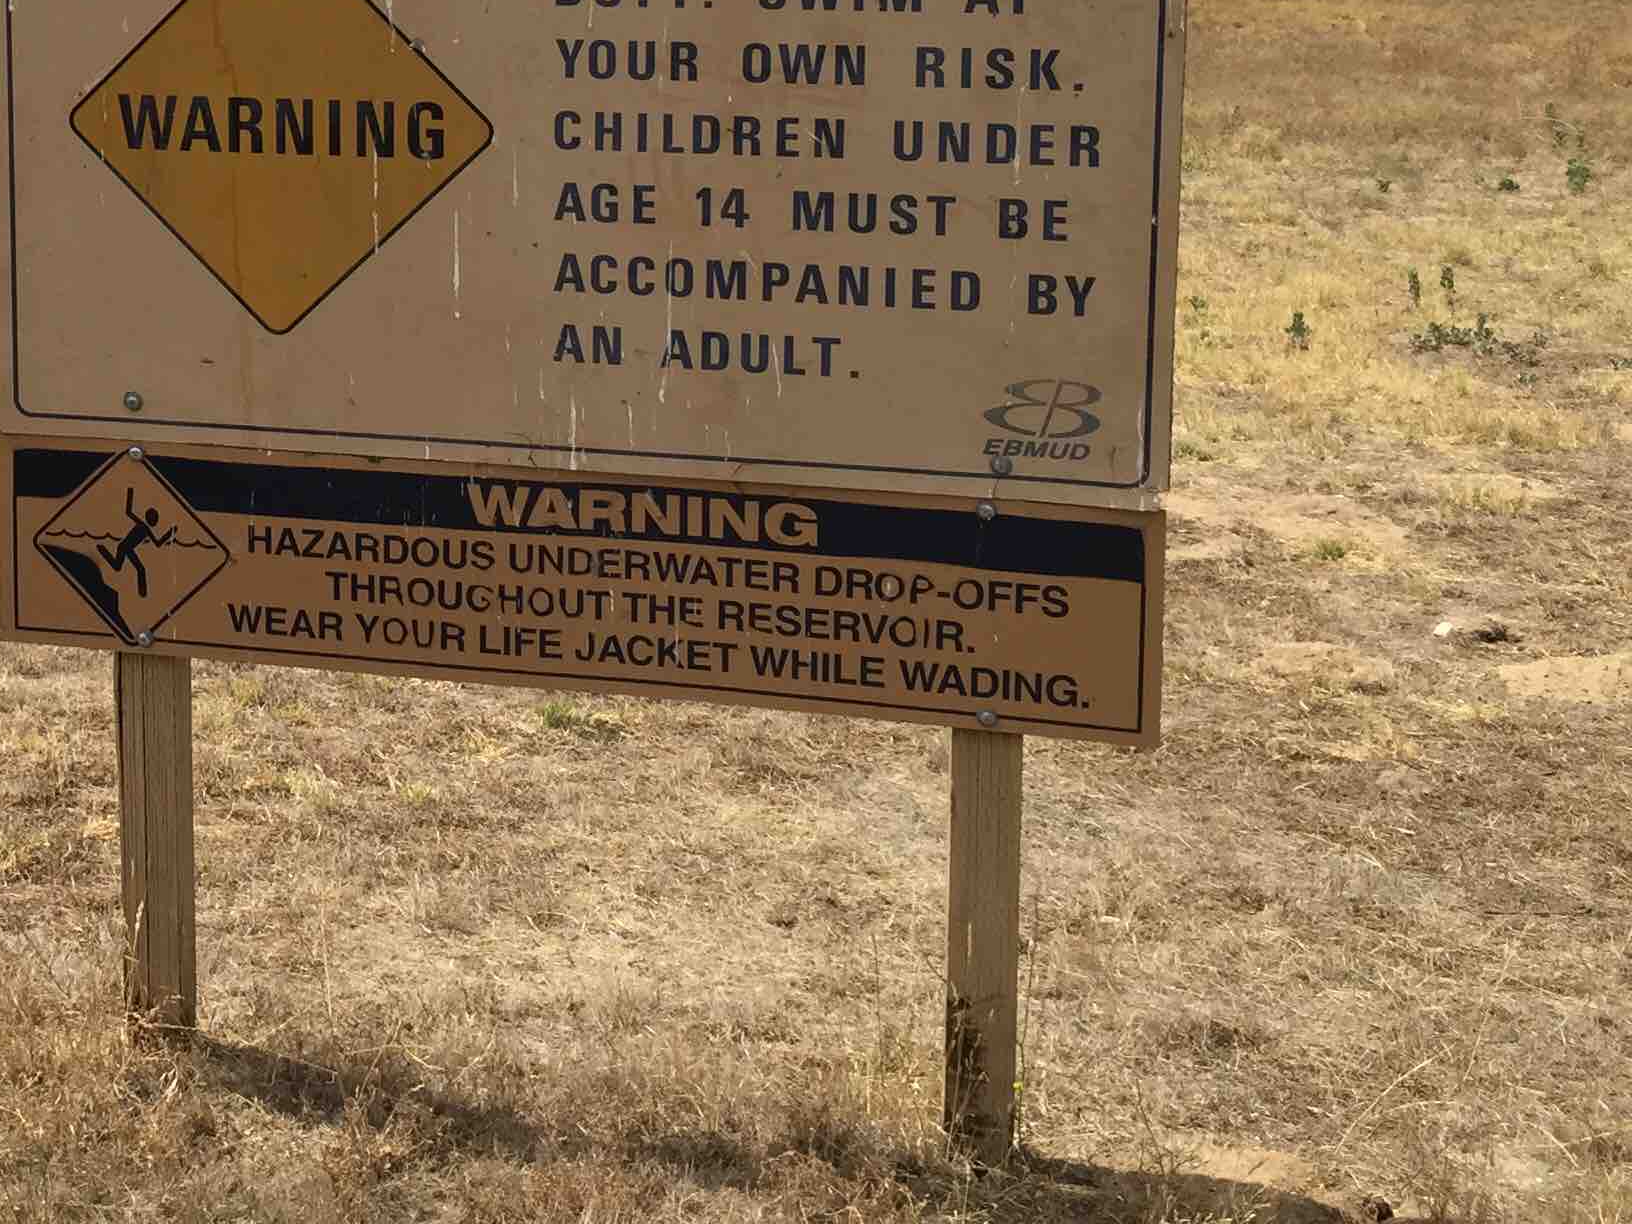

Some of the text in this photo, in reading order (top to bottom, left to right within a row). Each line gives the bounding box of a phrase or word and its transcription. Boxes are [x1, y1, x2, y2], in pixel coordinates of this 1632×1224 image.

[556, 39, 1083, 91] YOUR OWN RISK.
[118, 93, 445, 160] WARNING
[554, 111, 1101, 167] CHILDREN UNDER
[554, 182, 1069, 241] AGE 14 MUST BE
[553, 253, 1096, 317] ACCOMPANIED BY
[553, 324, 858, 378] AN ADULT.
[982, 438, 1090, 460] EBMUD
[466, 482, 818, 548] WARNING
[248, 525, 1069, 618] HAZARDOUS UNDERWATER DROP-OFFS
[325, 571, 975, 654] THROUGHOUT THE RESERVOIR.
[229, 604, 1089, 709] WEAR YOUR LIFE JACKET WHILE WADING.
